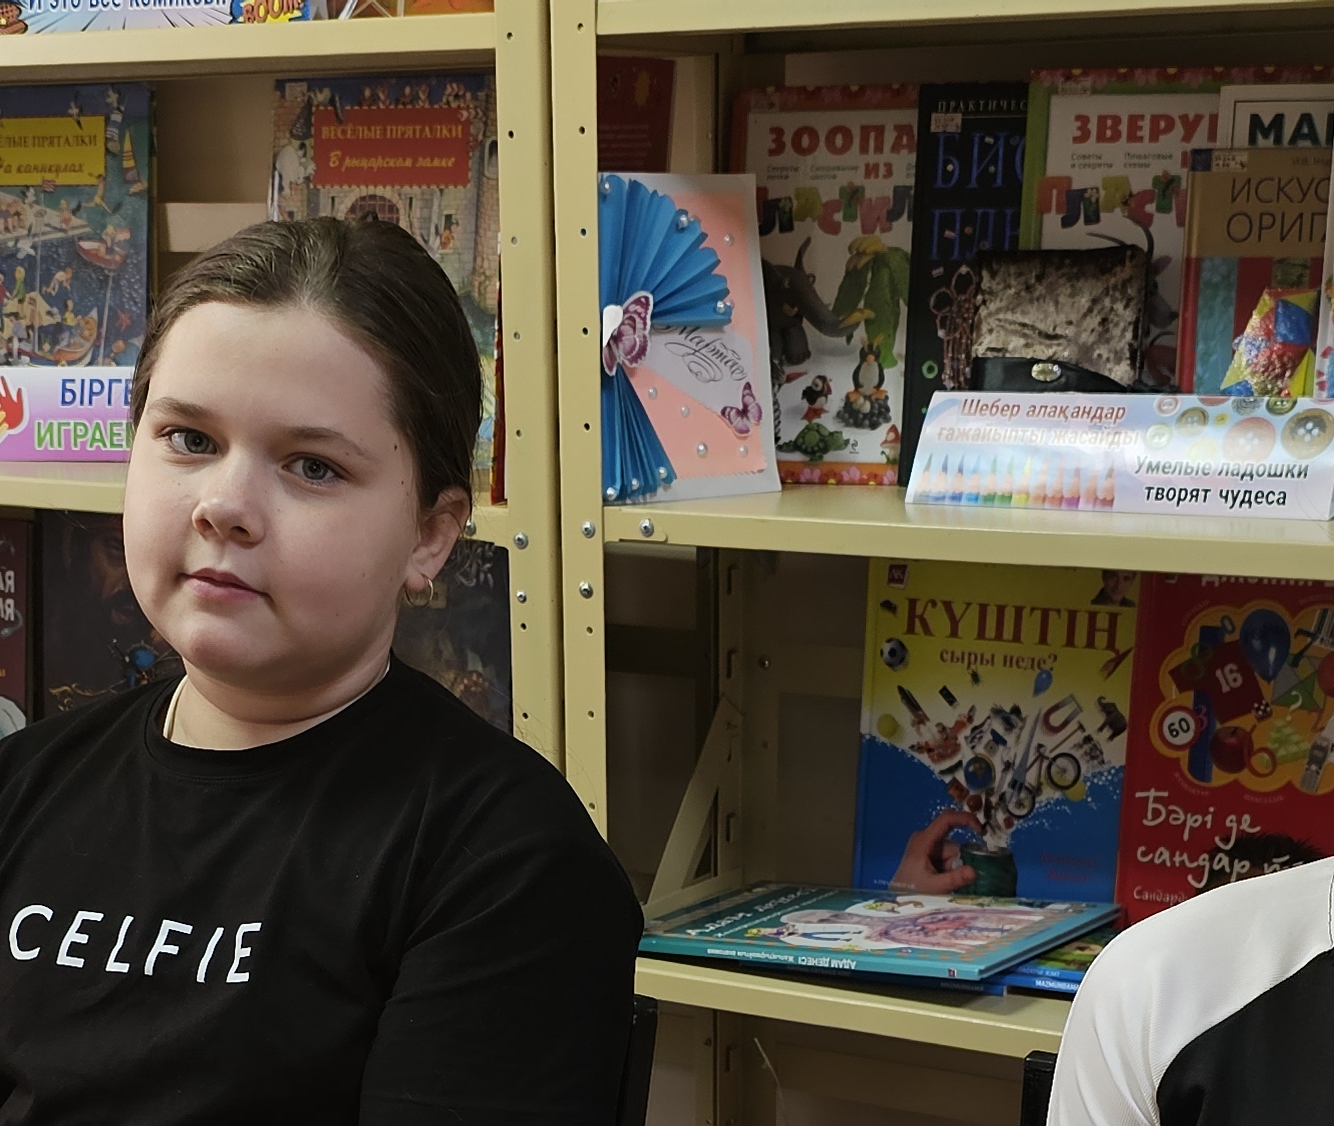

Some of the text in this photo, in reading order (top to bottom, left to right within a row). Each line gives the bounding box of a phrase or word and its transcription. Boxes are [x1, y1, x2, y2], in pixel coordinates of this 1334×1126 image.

[31, 134, 98, 148] ПРЯТАЛКИ
[321, 123, 463, 139] ВЕСЁЛЫЕ ПРЯТАЛКИ
[16, 161, 85, 178] каникулах
[328, 151, 342, 168] В
[416, 156, 456, 168] замке
[864, 162, 894, 180] ИЗ
[959, 398, 1126, 423] Шебер алақандар
[36, 421, 133, 449] ИГРАЕ
[936, 423, 1140, 448] ғажайыпты жасайды
[1134, 455, 1309, 481] Умелые ладошки
[1143, 487, 1287, 509] творят чудеса
[902, 598, 1123, 655] КҮШТІҢ
[939, 648, 1058, 673] сыры неде?
[1216, 663, 1243, 694] 16
[1168, 717, 1191, 738] 60
[1135, 788, 1261, 851] Бәрі де
[1136, 845, 1250, 889] сандар
[8, 904, 263, 983] CELFIE
[798, 956, 829, 967] ДЕНЕСІ
[830, 959, 857, 970] АДАМ
